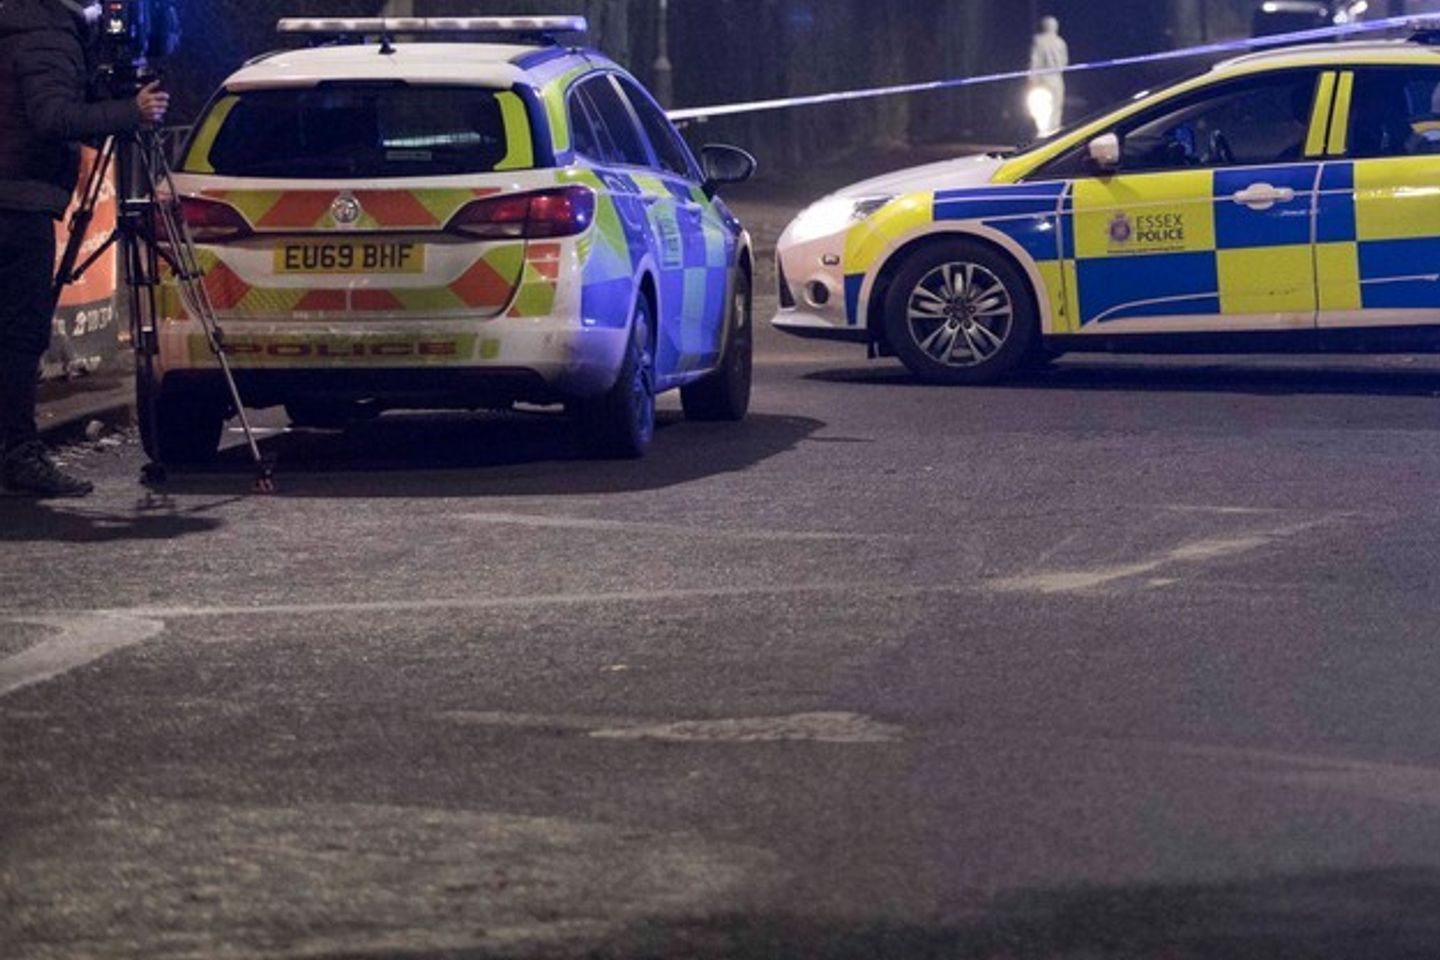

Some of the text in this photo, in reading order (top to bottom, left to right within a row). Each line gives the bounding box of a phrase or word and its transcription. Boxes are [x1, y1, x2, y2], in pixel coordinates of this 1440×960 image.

[1136, 212, 1183, 230] ESSEX
[1136, 228, 1184, 242] POLICE
[285, 242, 413, 269] EU69 BHF
[211, 342, 456, 357] POLICE
